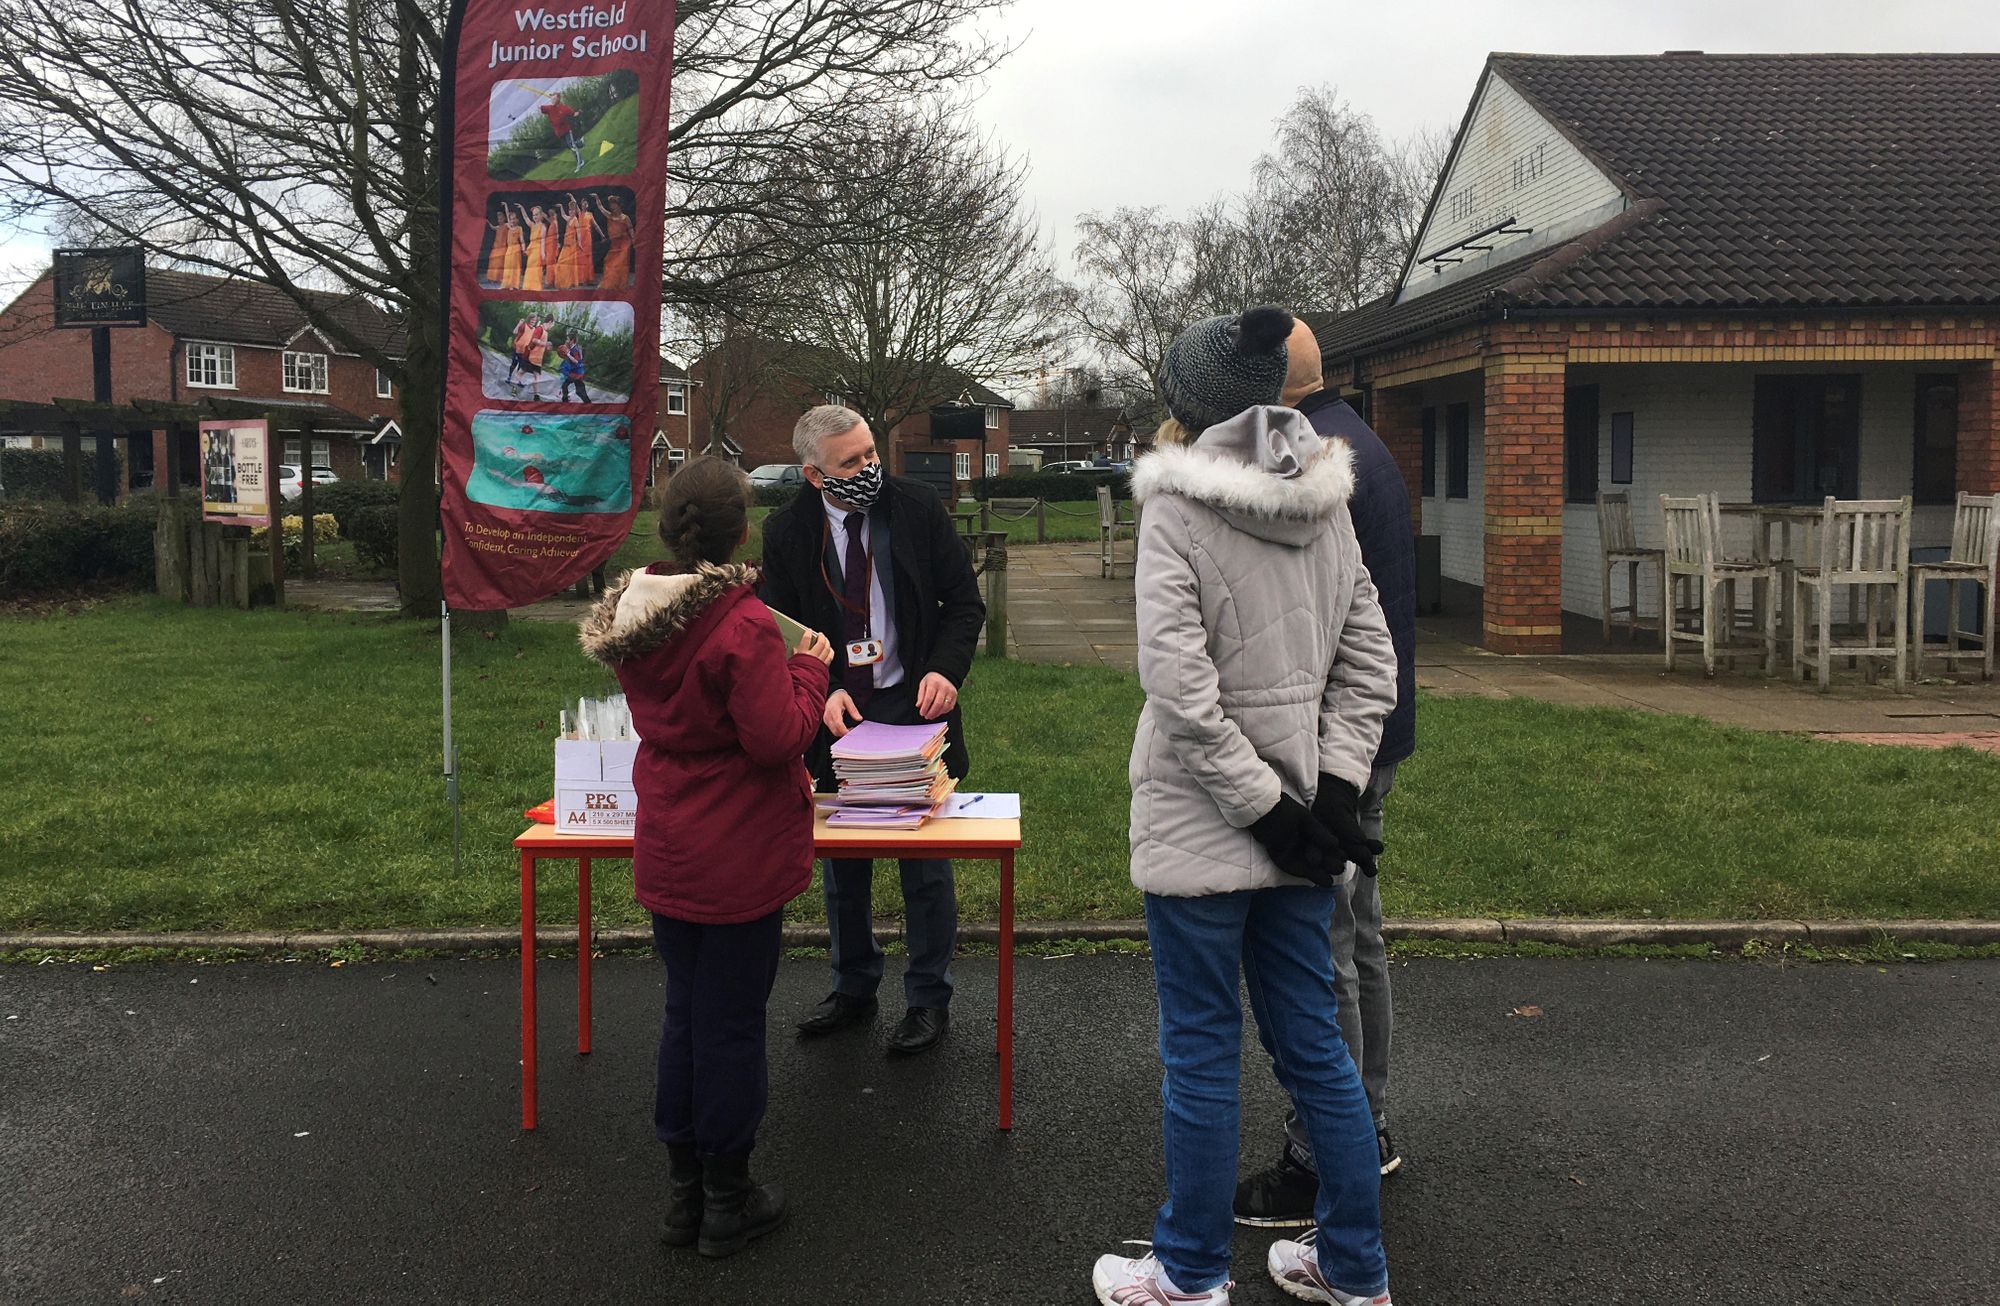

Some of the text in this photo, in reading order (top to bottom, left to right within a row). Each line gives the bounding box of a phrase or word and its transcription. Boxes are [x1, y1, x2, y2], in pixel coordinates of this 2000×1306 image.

[515, 1, 627, 32] Westfield
[488, 29, 647, 69] Junior School
[1450, 184, 1478, 224] THE
[1513, 141, 1548, 190] HAT
[236, 462, 263, 474] BOTTLE
[241, 474, 259, 486] FREE
[464, 521, 474, 533] To
[476, 524, 510, 539] Develop
[512, 532, 524, 541] an
[507, 544, 538, 559] Caring
[539, 546, 580, 557] Achiever
[585, 793, 618, 804] PPC
[567, 811, 587, 824] A4
